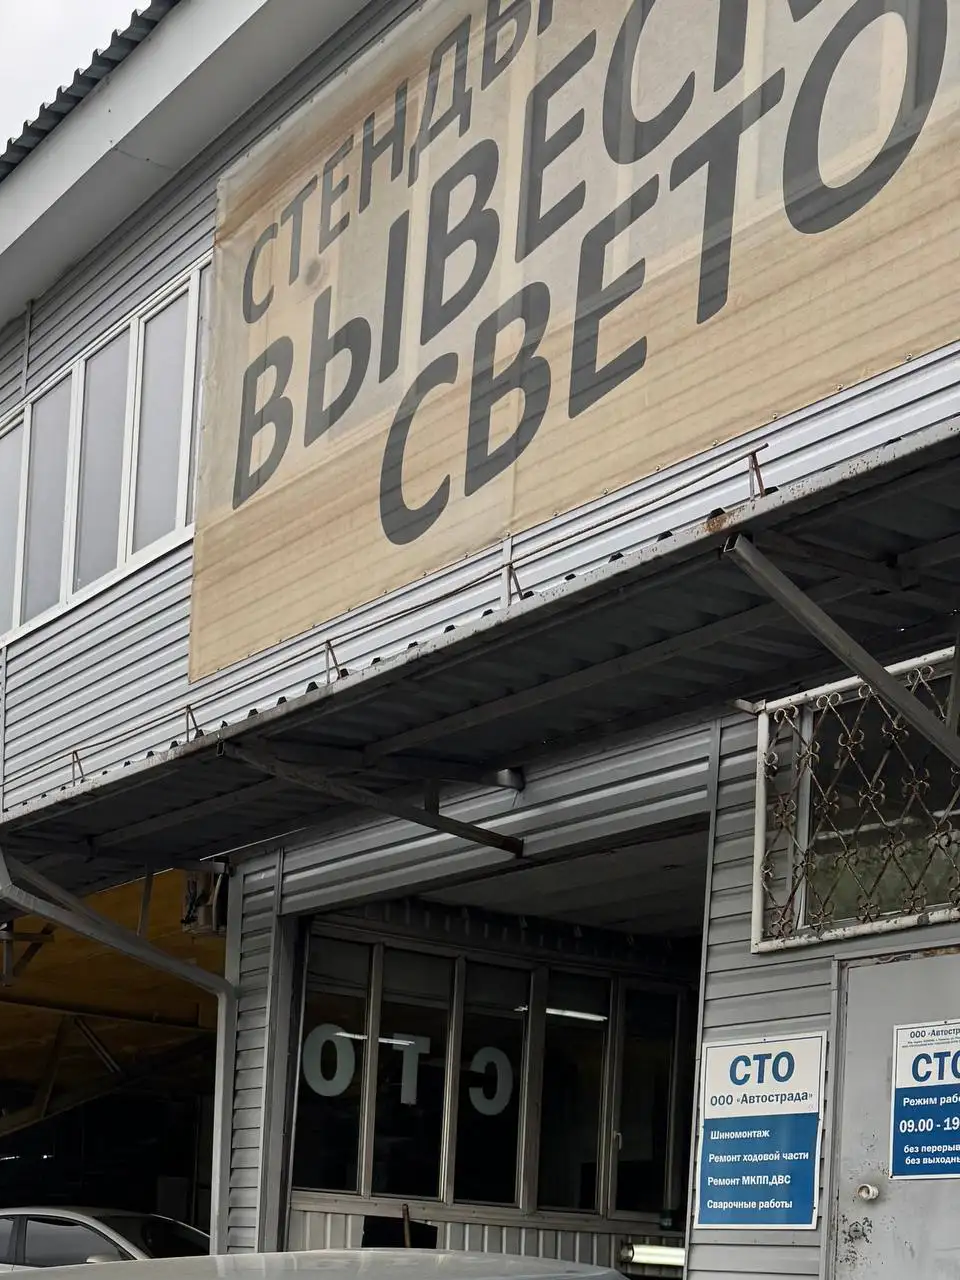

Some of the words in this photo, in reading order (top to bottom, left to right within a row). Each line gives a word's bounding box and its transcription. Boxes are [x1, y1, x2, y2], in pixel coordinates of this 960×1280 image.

[379, 0, 947, 546] СВЕТО
[910, 1030, 926, 1039] ООО
[729, 1051, 795, 1086] СТО
[710, 1094, 734, 1106] ООО
[736, 1091, 813, 1106] «Автострада»
[902, 1096, 938, 1107] Режим
[940, 1093, 960, 1106] раб
[899, 1118, 934, 1133] 09.00
[710, 1129, 770, 1140] Шиномонтаж
[903, 1144, 919, 1154] без
[921, 1144, 960, 1154] перерыв
[708, 1153, 741, 1163] Ремонт
[742, 1150, 780, 1163] ходовой
[782, 1151, 809, 1161] части
[905, 1156, 921, 1165] без
[707, 1176, 740, 1186] Ремонт
[707, 1199, 757, 1211] Сварочные
[758, 1198, 793, 1211] работы
